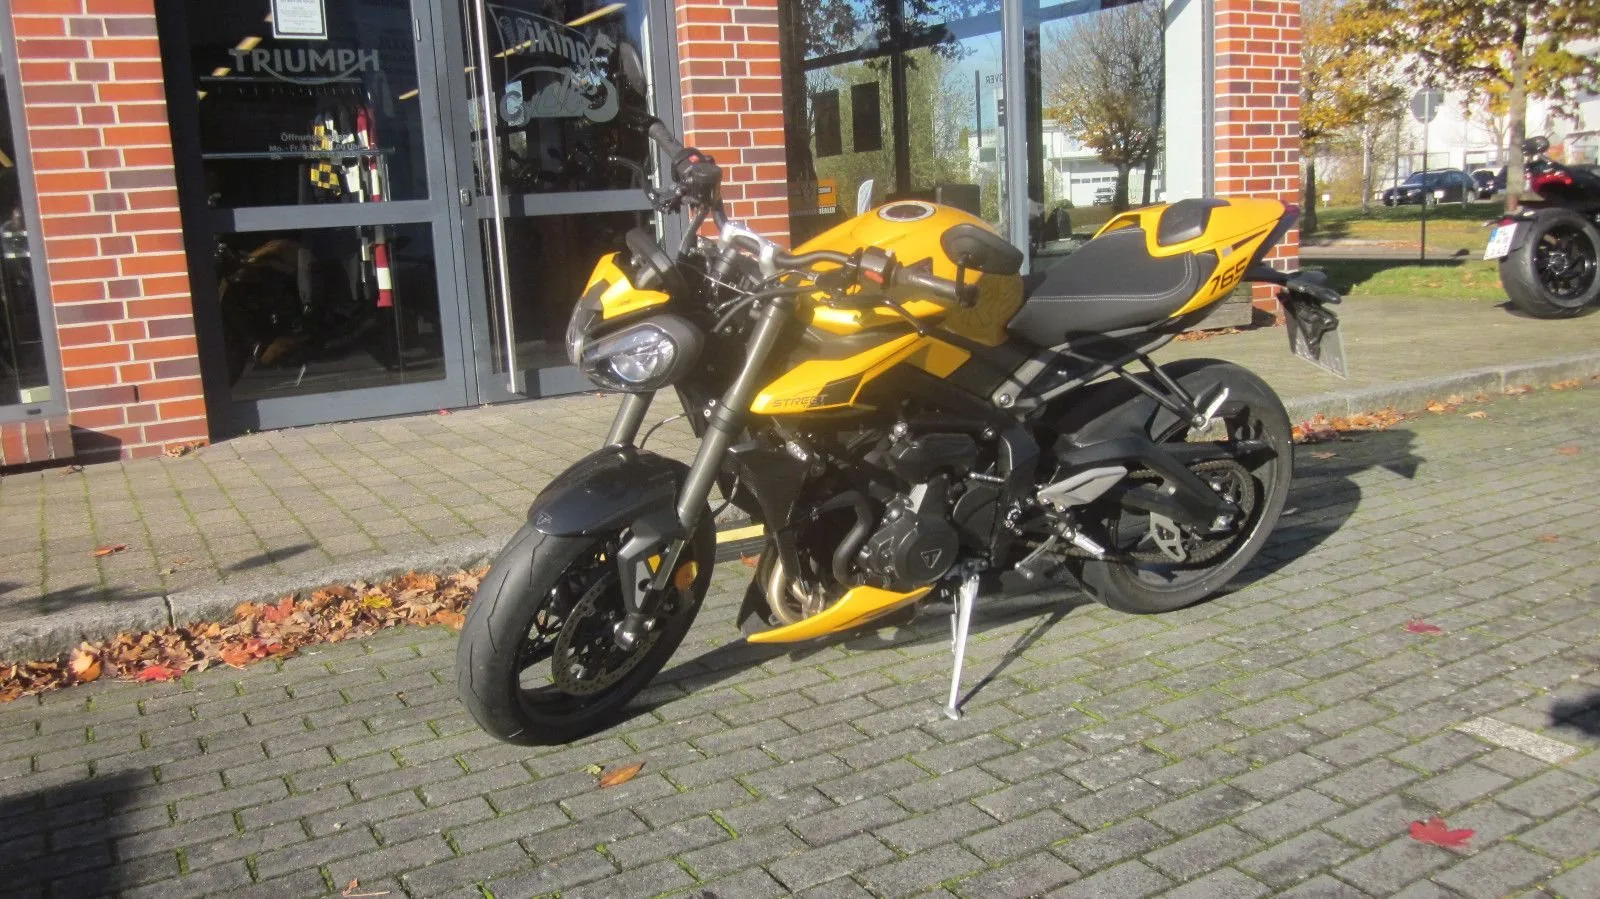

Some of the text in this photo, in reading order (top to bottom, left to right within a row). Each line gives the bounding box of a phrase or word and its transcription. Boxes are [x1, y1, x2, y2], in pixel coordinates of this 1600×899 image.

[228, 48, 380, 79] TRIUMPH
[280, 133, 349, 143] Öffnungseen
[1210, 257, 1247, 296] 765
[772, 394, 829, 408] STREET
